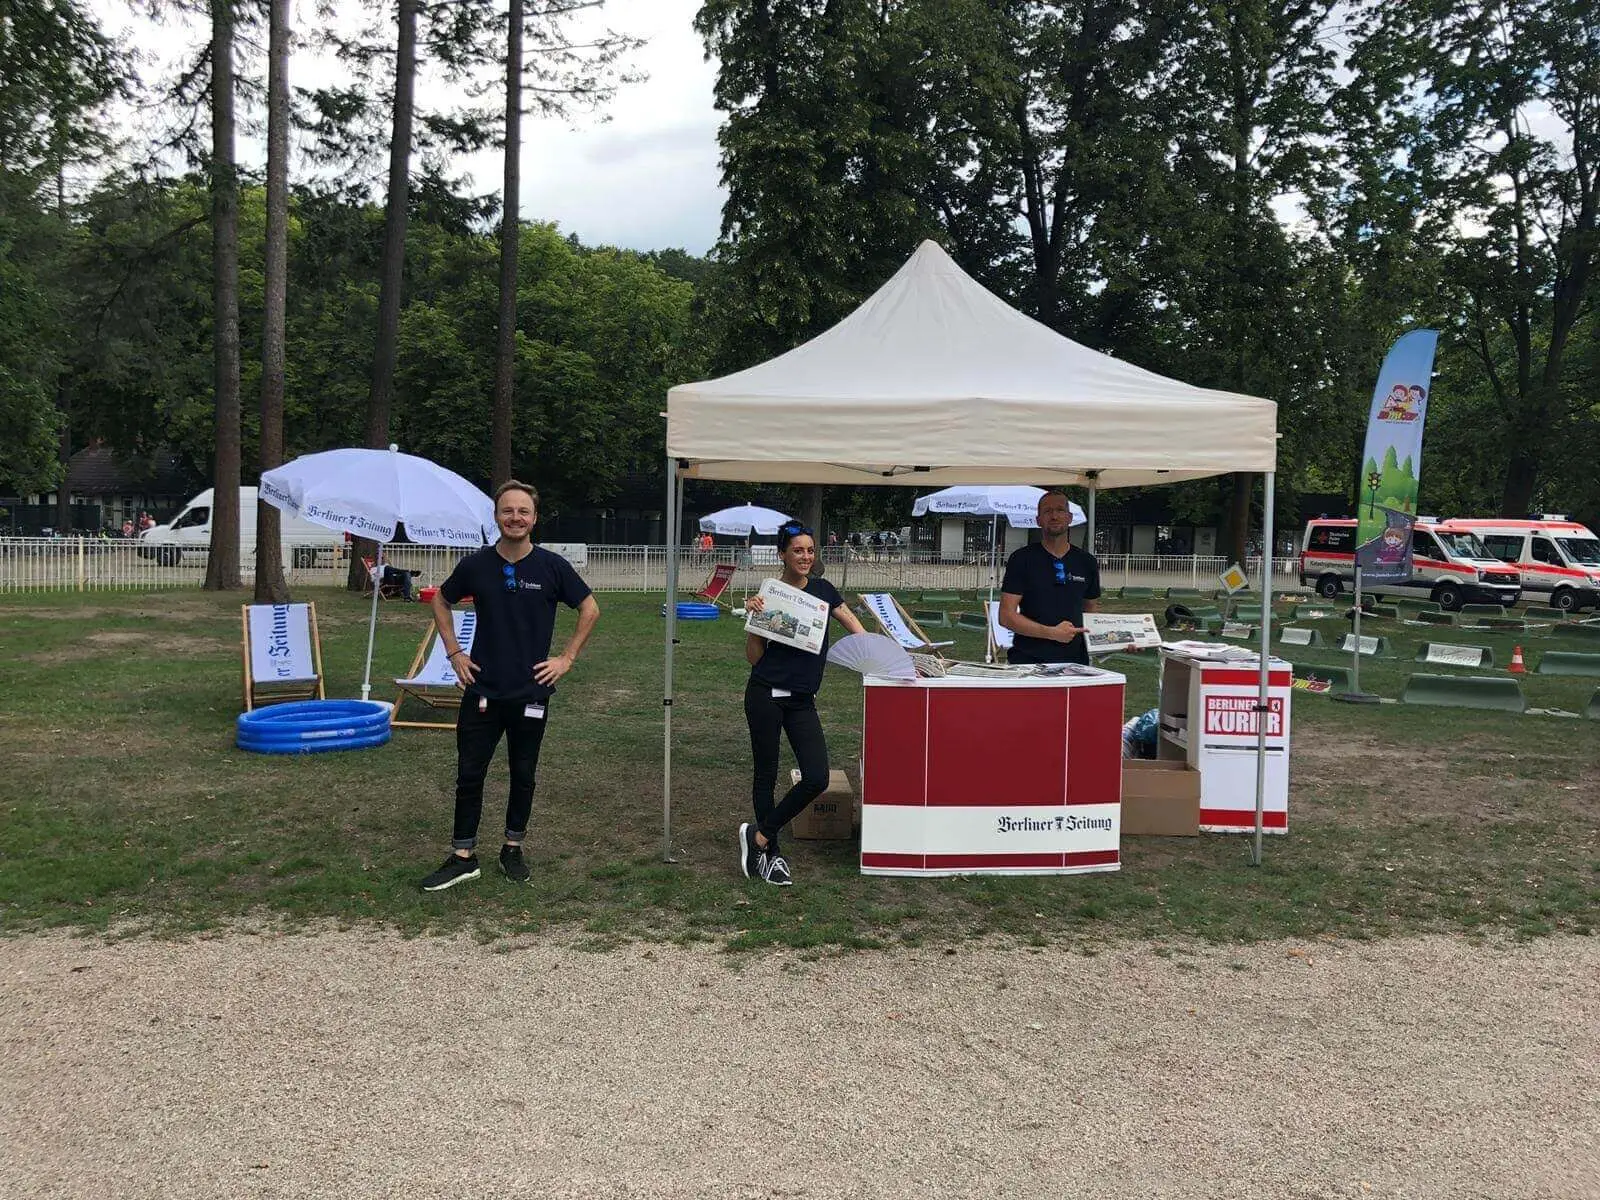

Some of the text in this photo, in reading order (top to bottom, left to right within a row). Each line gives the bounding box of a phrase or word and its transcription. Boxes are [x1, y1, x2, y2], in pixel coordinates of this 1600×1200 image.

[308, 504, 392, 537] Berliner Zeitung
[447, 528, 480, 542] Zeitung
[768, 585, 793, 600] Berliner
[997, 815, 1112, 832] Berliner Zeitung
